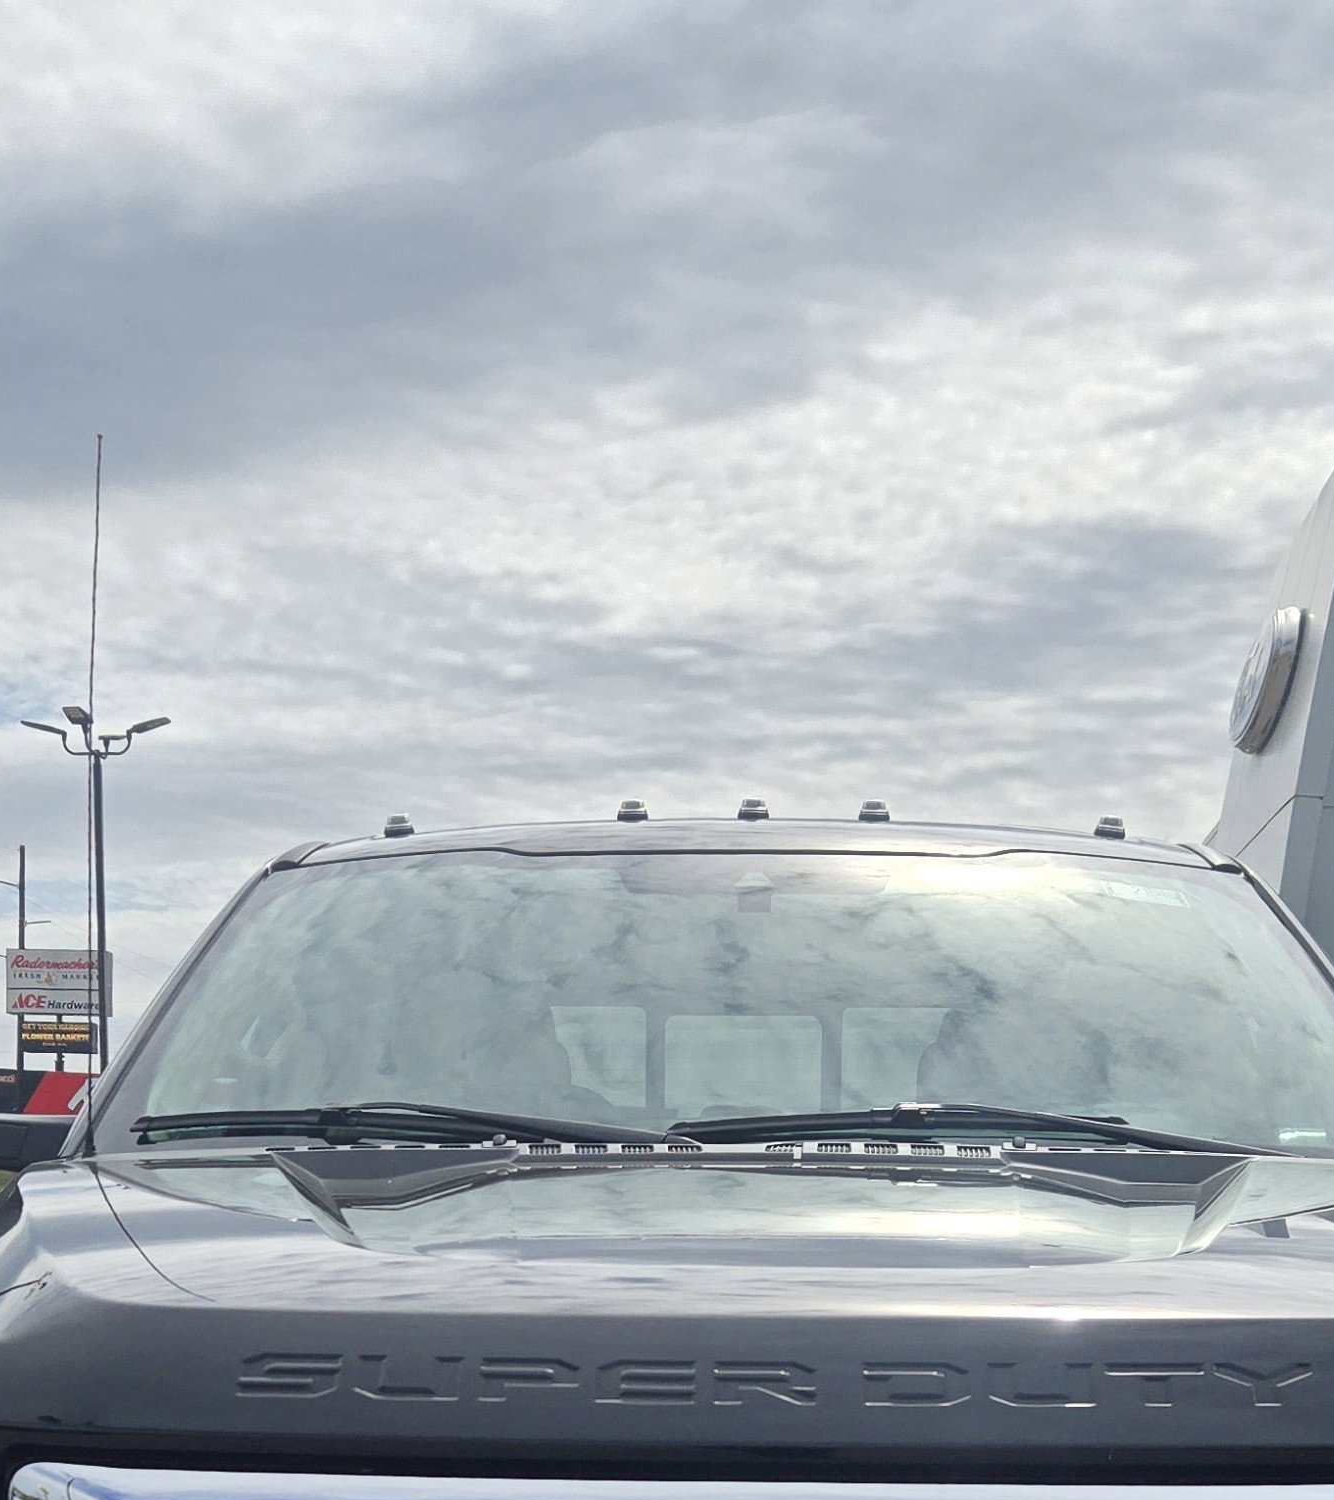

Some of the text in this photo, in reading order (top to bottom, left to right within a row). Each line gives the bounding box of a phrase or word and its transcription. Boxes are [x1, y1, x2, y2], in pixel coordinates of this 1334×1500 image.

[11, 993, 47, 1009] ACE
[234, 1351, 1314, 1408] SUPER DUTY
